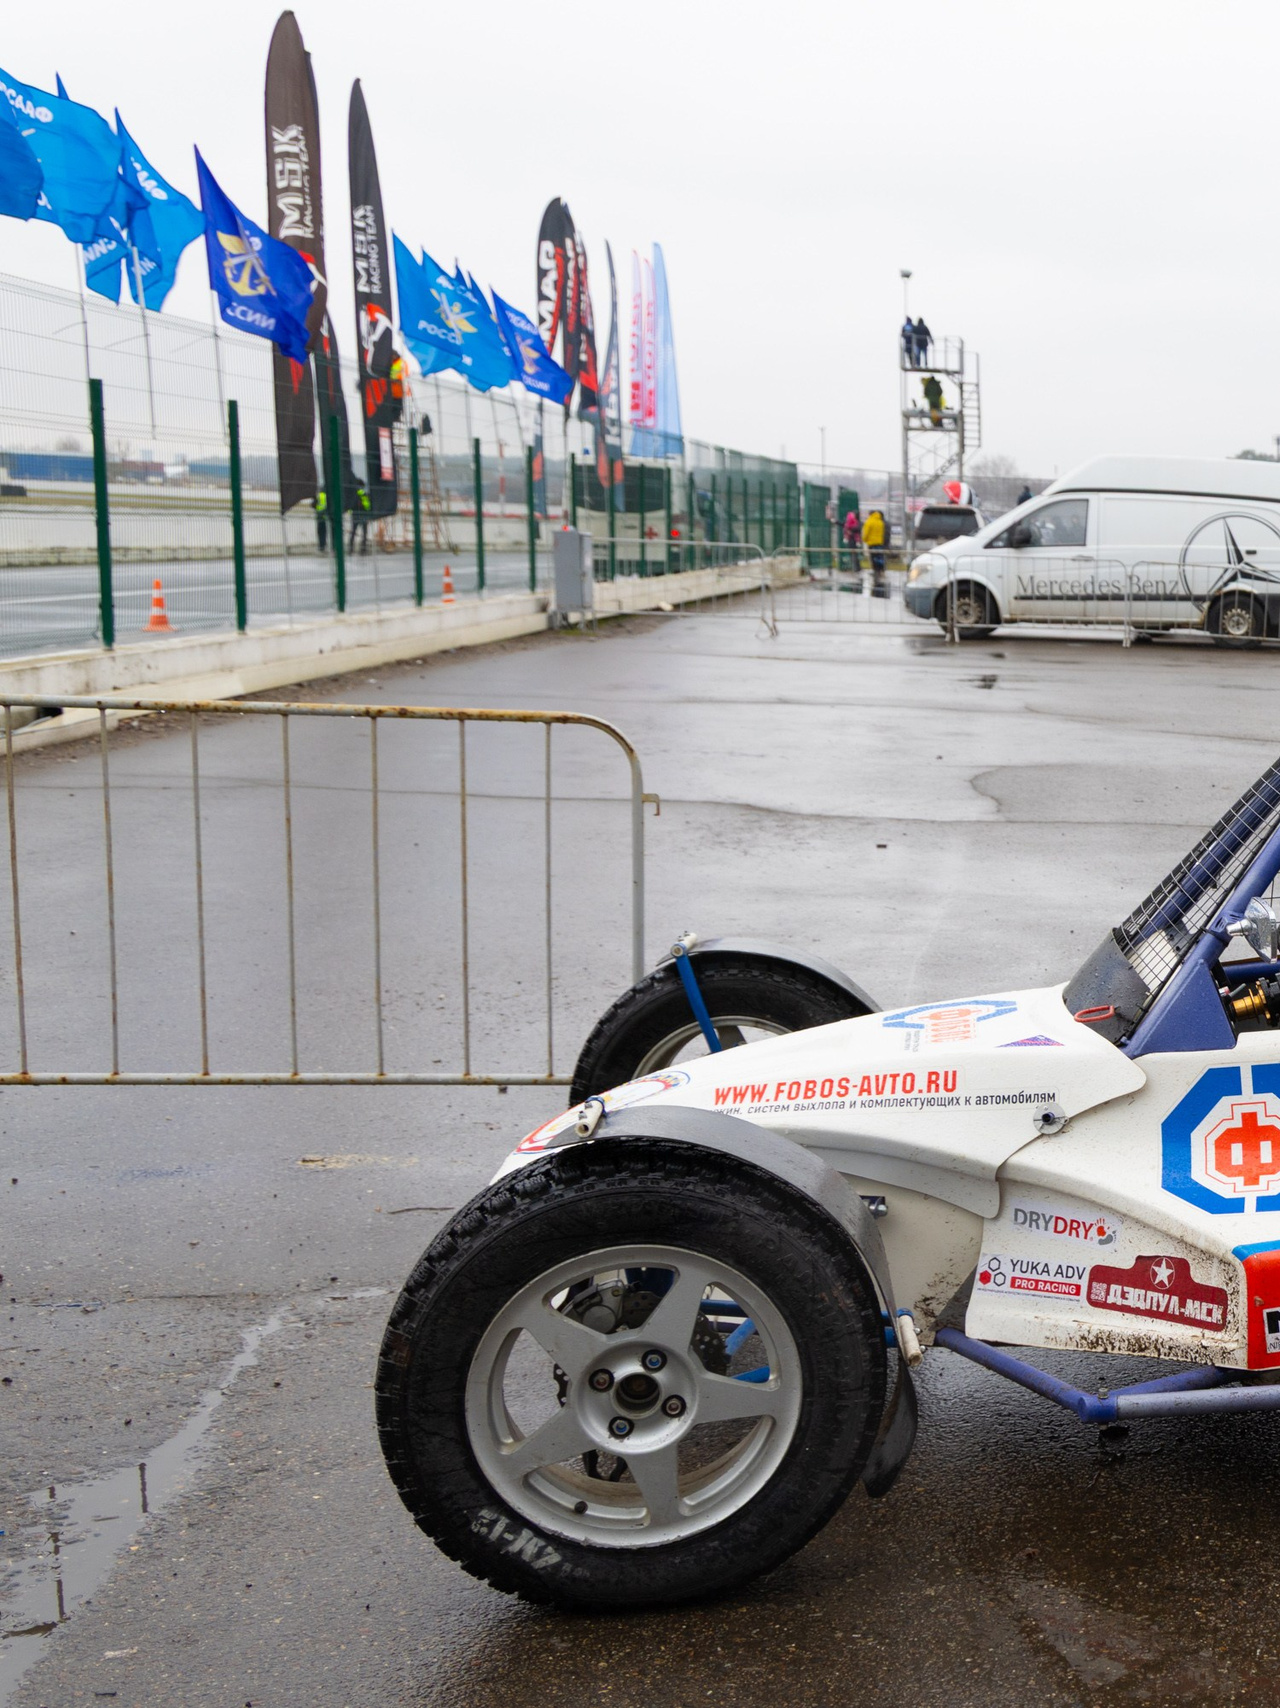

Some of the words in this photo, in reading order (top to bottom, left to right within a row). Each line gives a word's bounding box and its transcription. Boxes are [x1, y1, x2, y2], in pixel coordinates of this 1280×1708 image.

[368, 242, 382, 294] RACING
[714, 1070, 958, 1106] WWW.FOBOS-AVTO.RU
[747, 1103, 790, 1114] систем
[793, 1100, 845, 1112] выхлопа
[849, 1099, 857, 1109] и
[860, 1096, 961, 1110] комплектующих
[964, 1096, 972, 1105] к
[975, 1090, 1056, 1105] автомобилям
[1010, 1259, 1051, 1276] YUKA
[1054, 1264, 1086, 1280] ADV
[1015, 1278, 1036, 1290] PRO
[1037, 1281, 1077, 1294] RACING
